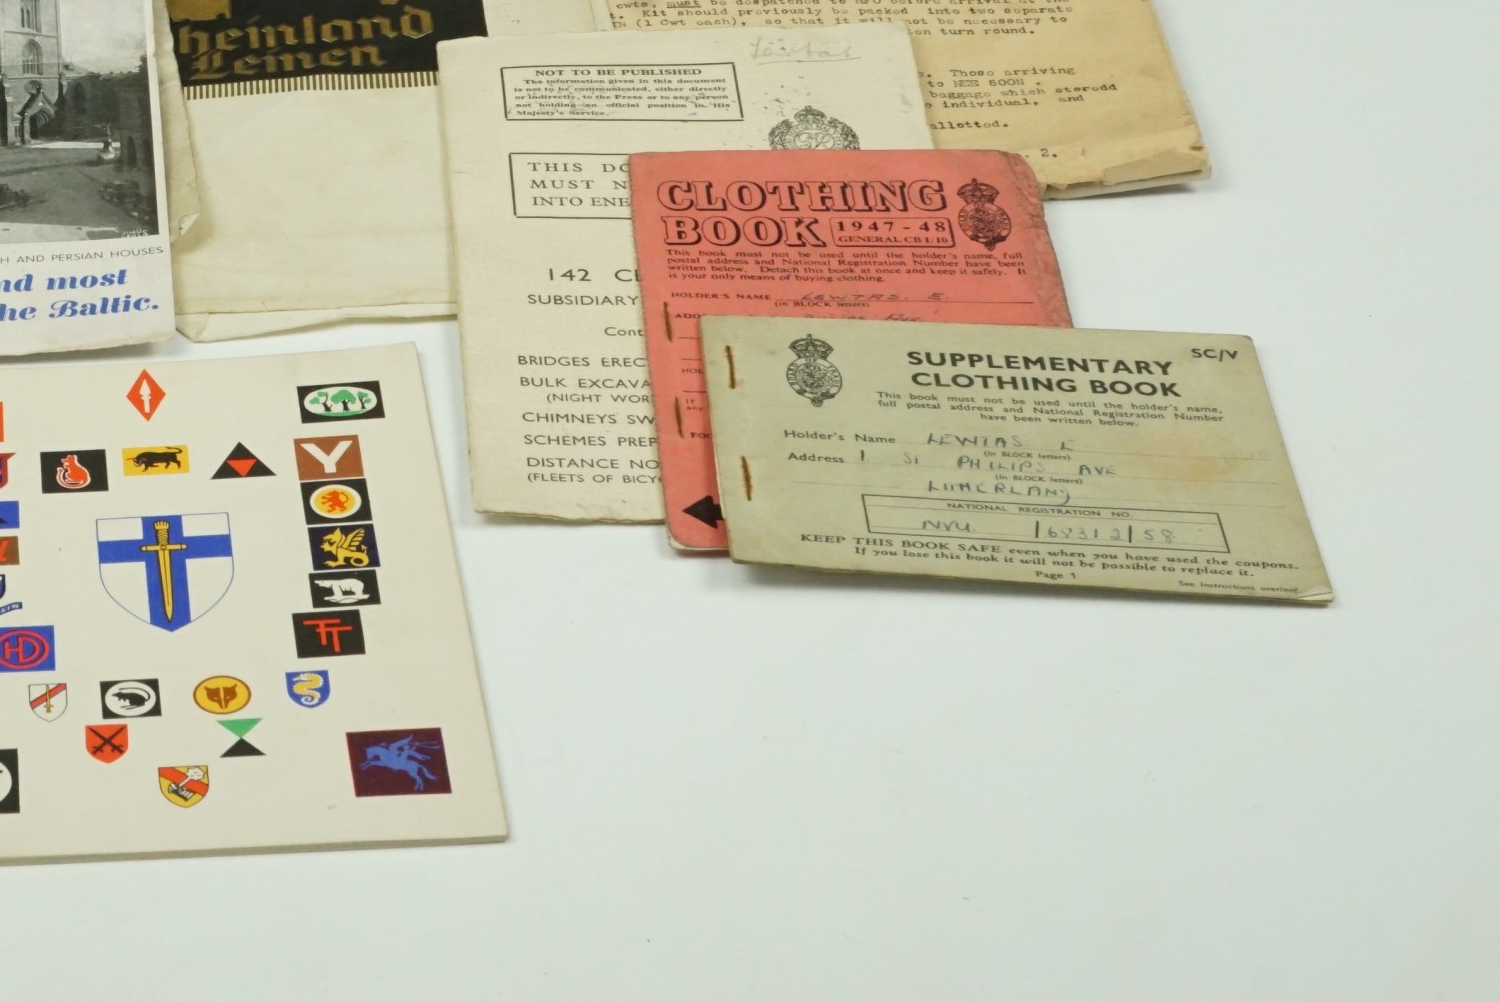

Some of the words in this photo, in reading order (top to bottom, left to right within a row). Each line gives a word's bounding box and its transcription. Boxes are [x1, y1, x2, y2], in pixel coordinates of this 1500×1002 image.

[621, 68, 702, 76] PUBLISHED
[527, 162, 583, 172] THIS
[530, 179, 595, 190] MUST
[532, 197, 583, 206] INTO
[656, 179, 947, 212] CLOTHING
[660, 215, 827, 247] BOOK
[838, 235, 901, 244] GENERAL
[904, 235, 923, 244] CB
[16, 254, 45, 263] AND
[51, 252, 103, 262] PERSIAN
[110, 246, 164, 257] HOUSES
[46, 269, 127, 291] most
[549, 268, 592, 282] 142
[527, 294, 639, 306] SUBSIDIARY
[671, 292, 730, 300] HOLDER'S
[48, 294, 160, 319] Baltic.
[517, 356, 591, 367] BRIDGES
[907, 351, 1173, 376] SUPPLEMENTARY
[1191, 348, 1238, 362] SC/V
[520, 376, 567, 388] BULK
[911, 372, 1078, 393] CLOTHING
[1090, 379, 1182, 398] BOOK
[546, 393, 602, 404] (NIGHT
[522, 412, 618, 424] CHIMNEYS
[524, 434, 607, 446] SCHEMES
[783, 429, 845, 442] Holder's
[854, 434, 896, 444] Name
[526, 457, 620, 470] DISTANCE
[788, 452, 845, 464] Address
[527, 472, 585, 484] (FLEETS
[592, 474, 613, 484] OF
[947, 502, 1007, 512] NATIONAL
[1018, 506, 1101, 517] REGISTRATION
[800, 534, 847, 545] KEEP
[853, 536, 893, 547] THIS
[901, 540, 949, 551] BOOK
[958, 543, 1001, 553] SAFE
[1009, 548, 1041, 556] even
[1047, 550, 1086, 559] when
[1092, 553, 1118, 562] you
[1125, 553, 1160, 563] have
[1167, 555, 1199, 565] used
[1206, 557, 1229, 566] the
[1236, 560, 1300, 571] coupons.
[1035, 570, 1063, 580] Page
[1070, 572, 1077, 580] 1
[4, 634, 41, 663] HD
